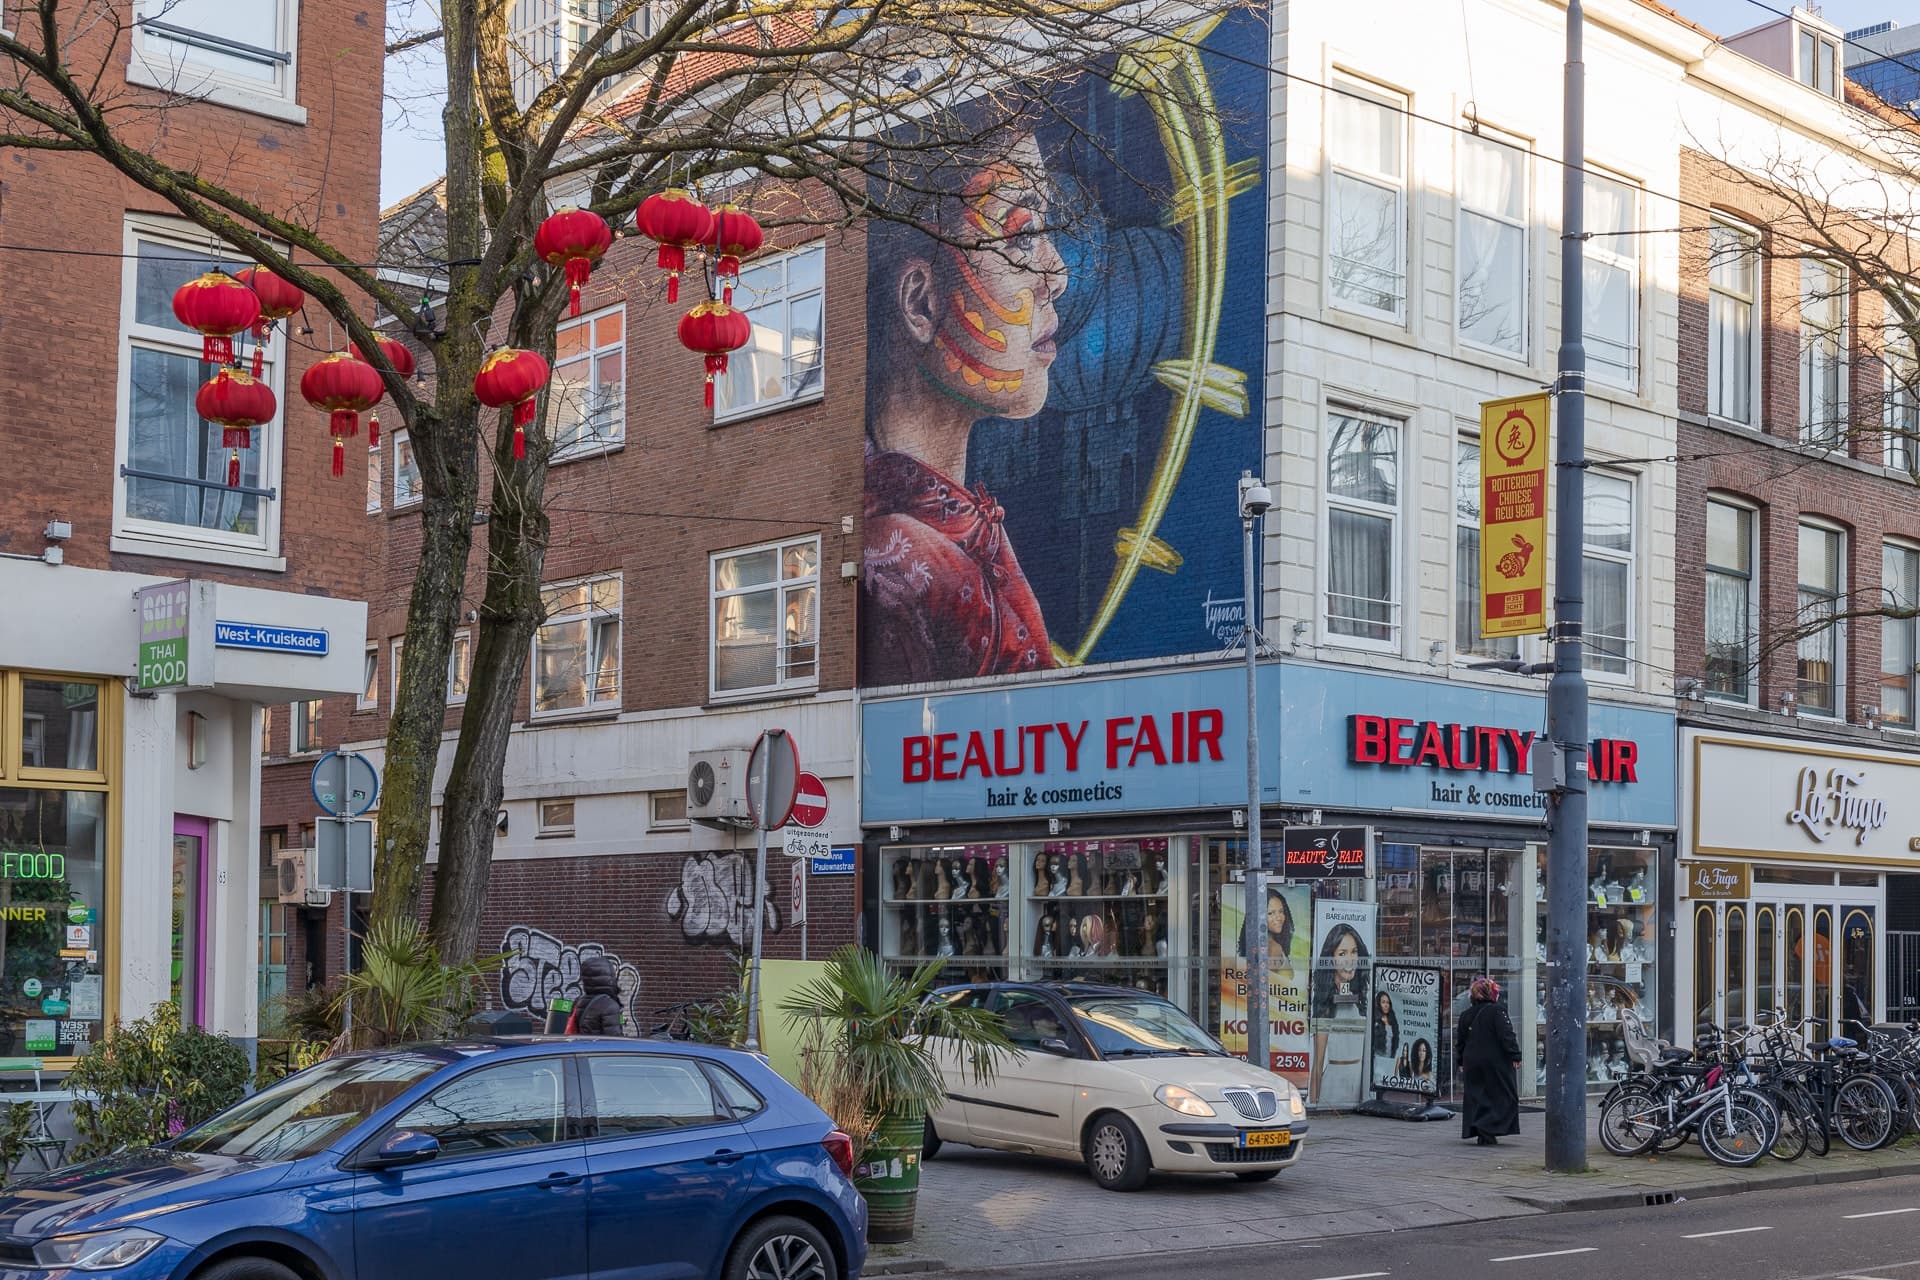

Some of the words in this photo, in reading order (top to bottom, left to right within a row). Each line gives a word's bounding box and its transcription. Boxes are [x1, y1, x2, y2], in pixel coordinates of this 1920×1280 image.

[1492, 473, 1539, 492] ROTTERDAM
[1499, 489, 1532, 506] CHINESE
[1495, 505, 1514, 520] NEW
[1515, 503, 1534, 518] YEAR
[217, 626, 320, 648] West-Kruiskade
[150, 643, 175, 660] THAI
[142, 660, 186, 687] FOOD
[902, 720, 1089, 784] BEAUTY
[1105, 708, 1225, 769] FAIR
[1347, 713, 1536, 775] BEAUTY
[987, 787, 1018, 808] hair
[1023, 787, 1038, 806] &
[1041, 781, 1122, 805] cosmetics
[1431, 781, 1463, 803] hair
[1467, 784, 1481, 805] &
[1485, 790, 1548, 809] cosmetic
[1787, 767, 1831, 843] La
[1826, 768, 1888, 846] Fuga
[787, 828, 829, 839] uitgezonderd
[1286, 850, 1327, 864] BEAUTY
[1338, 849, 1364, 863] FAIR
[4, 853, 65, 878] FOOD
[1695, 868, 1713, 889] La
[1712, 868, 1739, 889] Fuga
[1225, 968, 1247, 980] Rea
[1380, 969, 1435, 985] KORTING
[1237, 984, 1298, 996] Bilian
[1342, 984, 1350, 994] 61
[1387, 983, 1402, 992] 10%
[1410, 985, 1428, 995] 20%
[1278, 1000, 1307, 1012] Hair
[1224, 1020, 1305, 1035] KOTING
[1276, 1055, 1306, 1068] 25%
[1382, 1075, 1429, 1090] KORTING
[1248, 1133, 1289, 1145] 64-RS-DF
